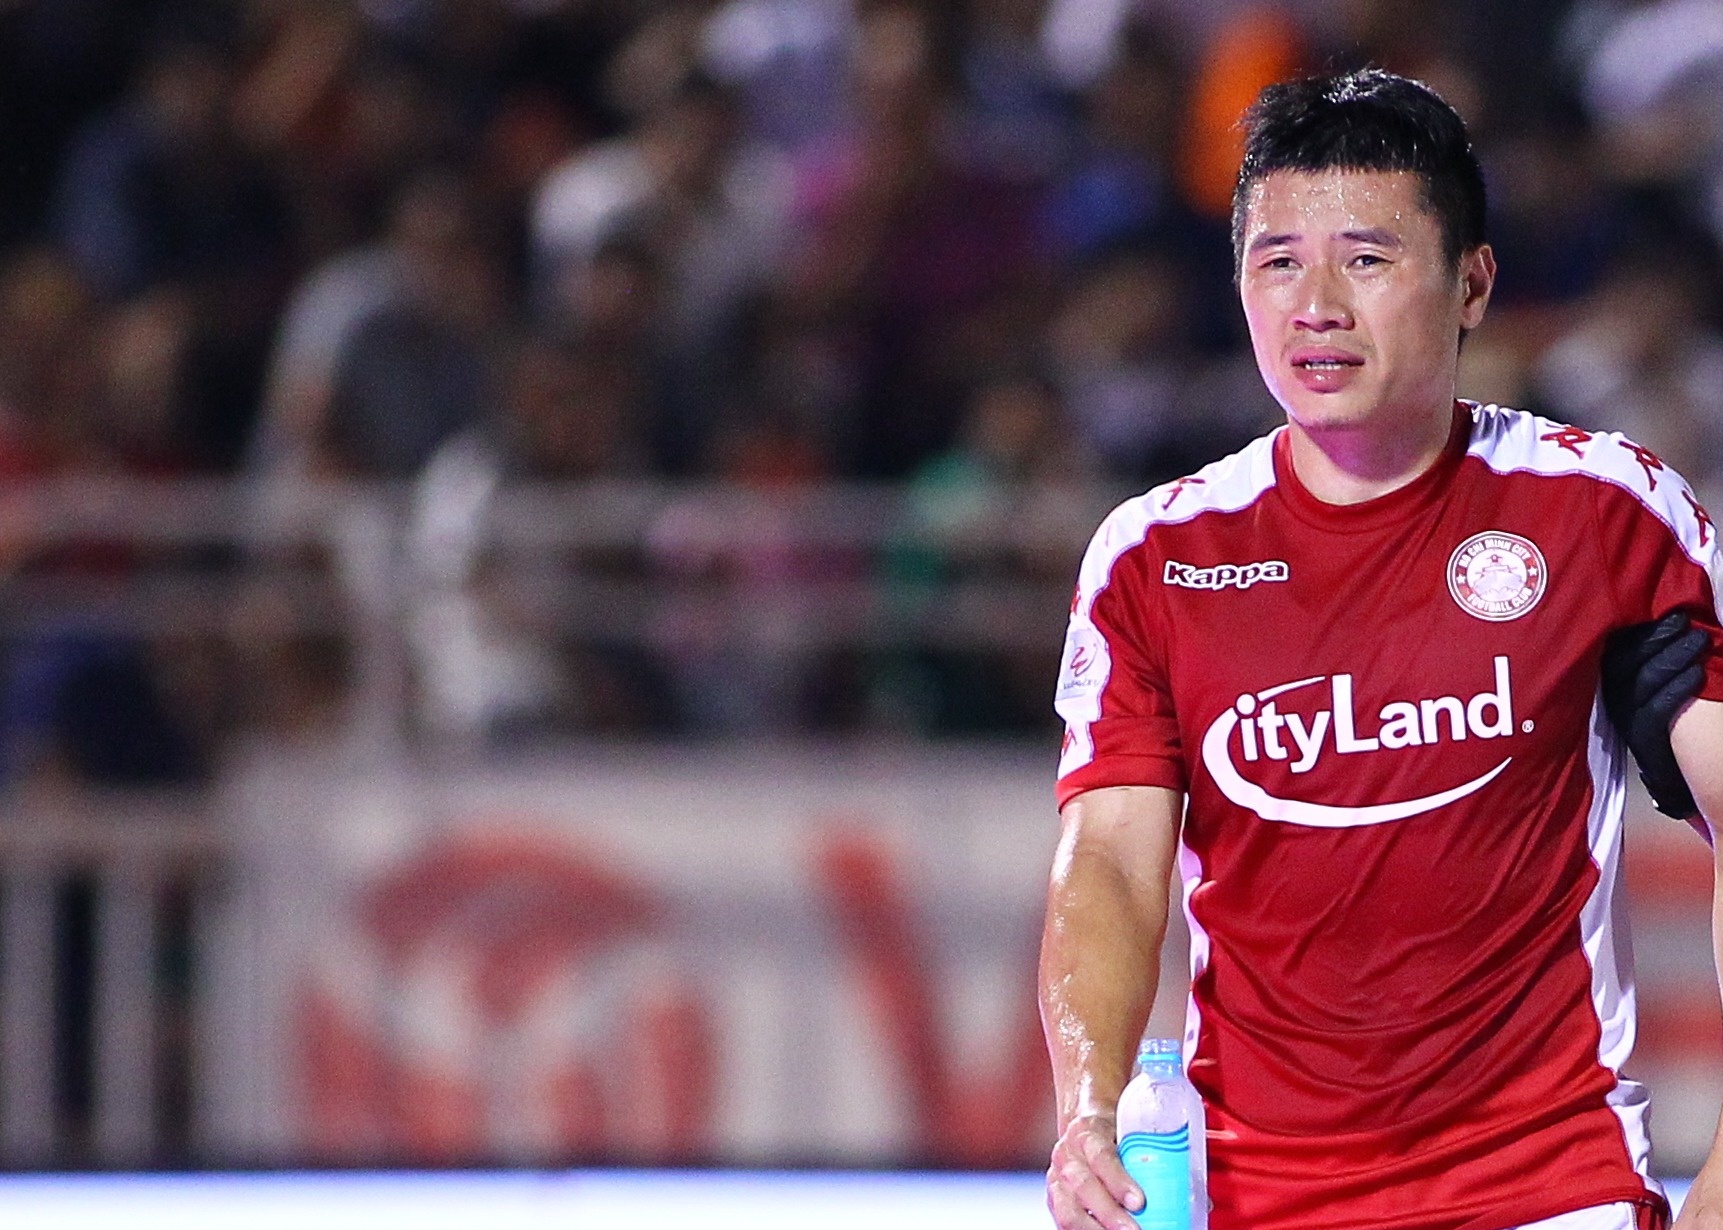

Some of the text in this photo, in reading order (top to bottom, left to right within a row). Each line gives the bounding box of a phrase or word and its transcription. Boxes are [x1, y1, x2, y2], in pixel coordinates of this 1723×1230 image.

[1467, 541, 1485, 556] CHI
[1485, 539, 1512, 551] MINH
[1511, 543, 1531, 560] CITY
[1163, 560, 1288, 591] Kappa
[1467, 587, 1533, 613] FOOTBALL CLUB
